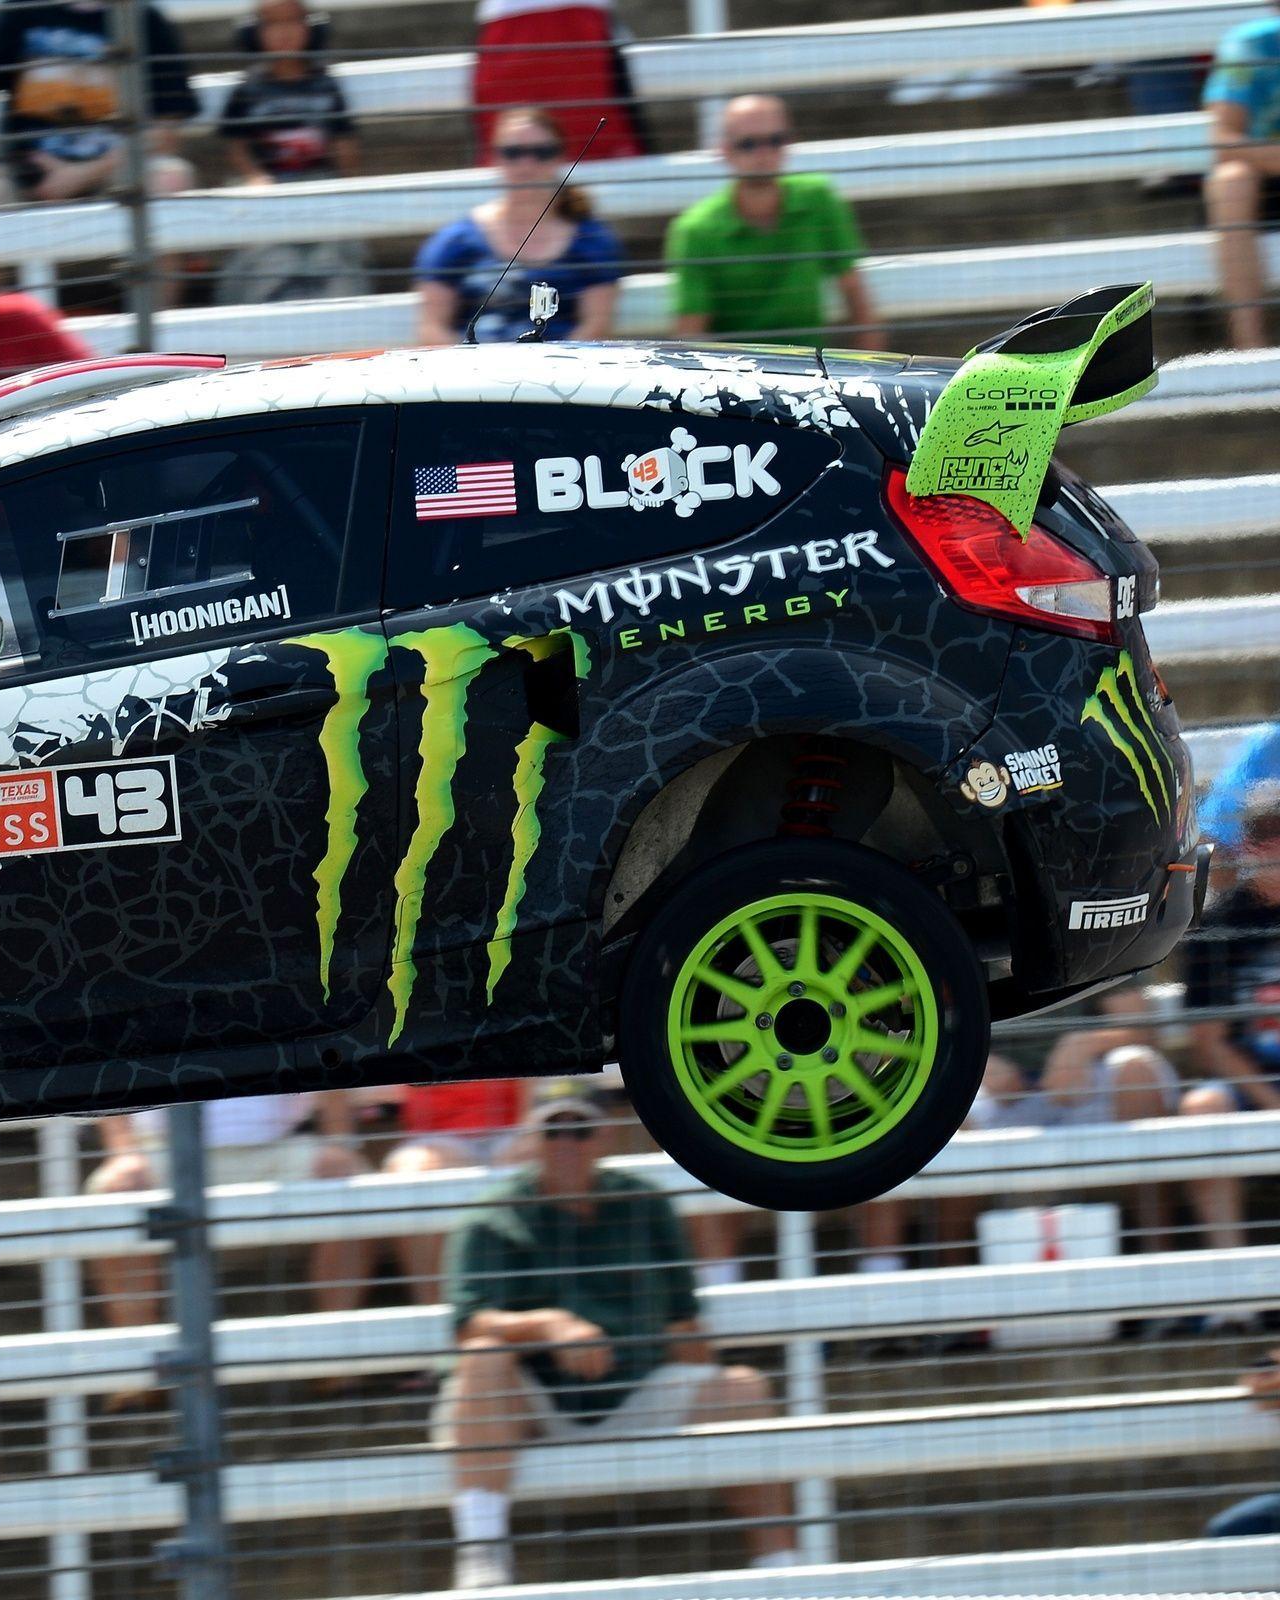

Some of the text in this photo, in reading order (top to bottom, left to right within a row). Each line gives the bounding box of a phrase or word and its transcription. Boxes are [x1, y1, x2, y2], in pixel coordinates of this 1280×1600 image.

[966, 387, 1058, 400] GoPro
[535, 441, 781, 513] BLCK
[634, 457, 658, 482] 43
[940, 457, 1008, 478] RYNO
[937, 476, 1019, 490] POWER
[553, 529, 896, 623] MONSTER
[620, 588, 850, 650] ENERGY
[0, 783, 39, 798] TEXAS
[1011, 761, 1062, 791] MOKEY
[64, 768, 168, 836] 43
[1068, 892, 1150, 930] PIRELLI
